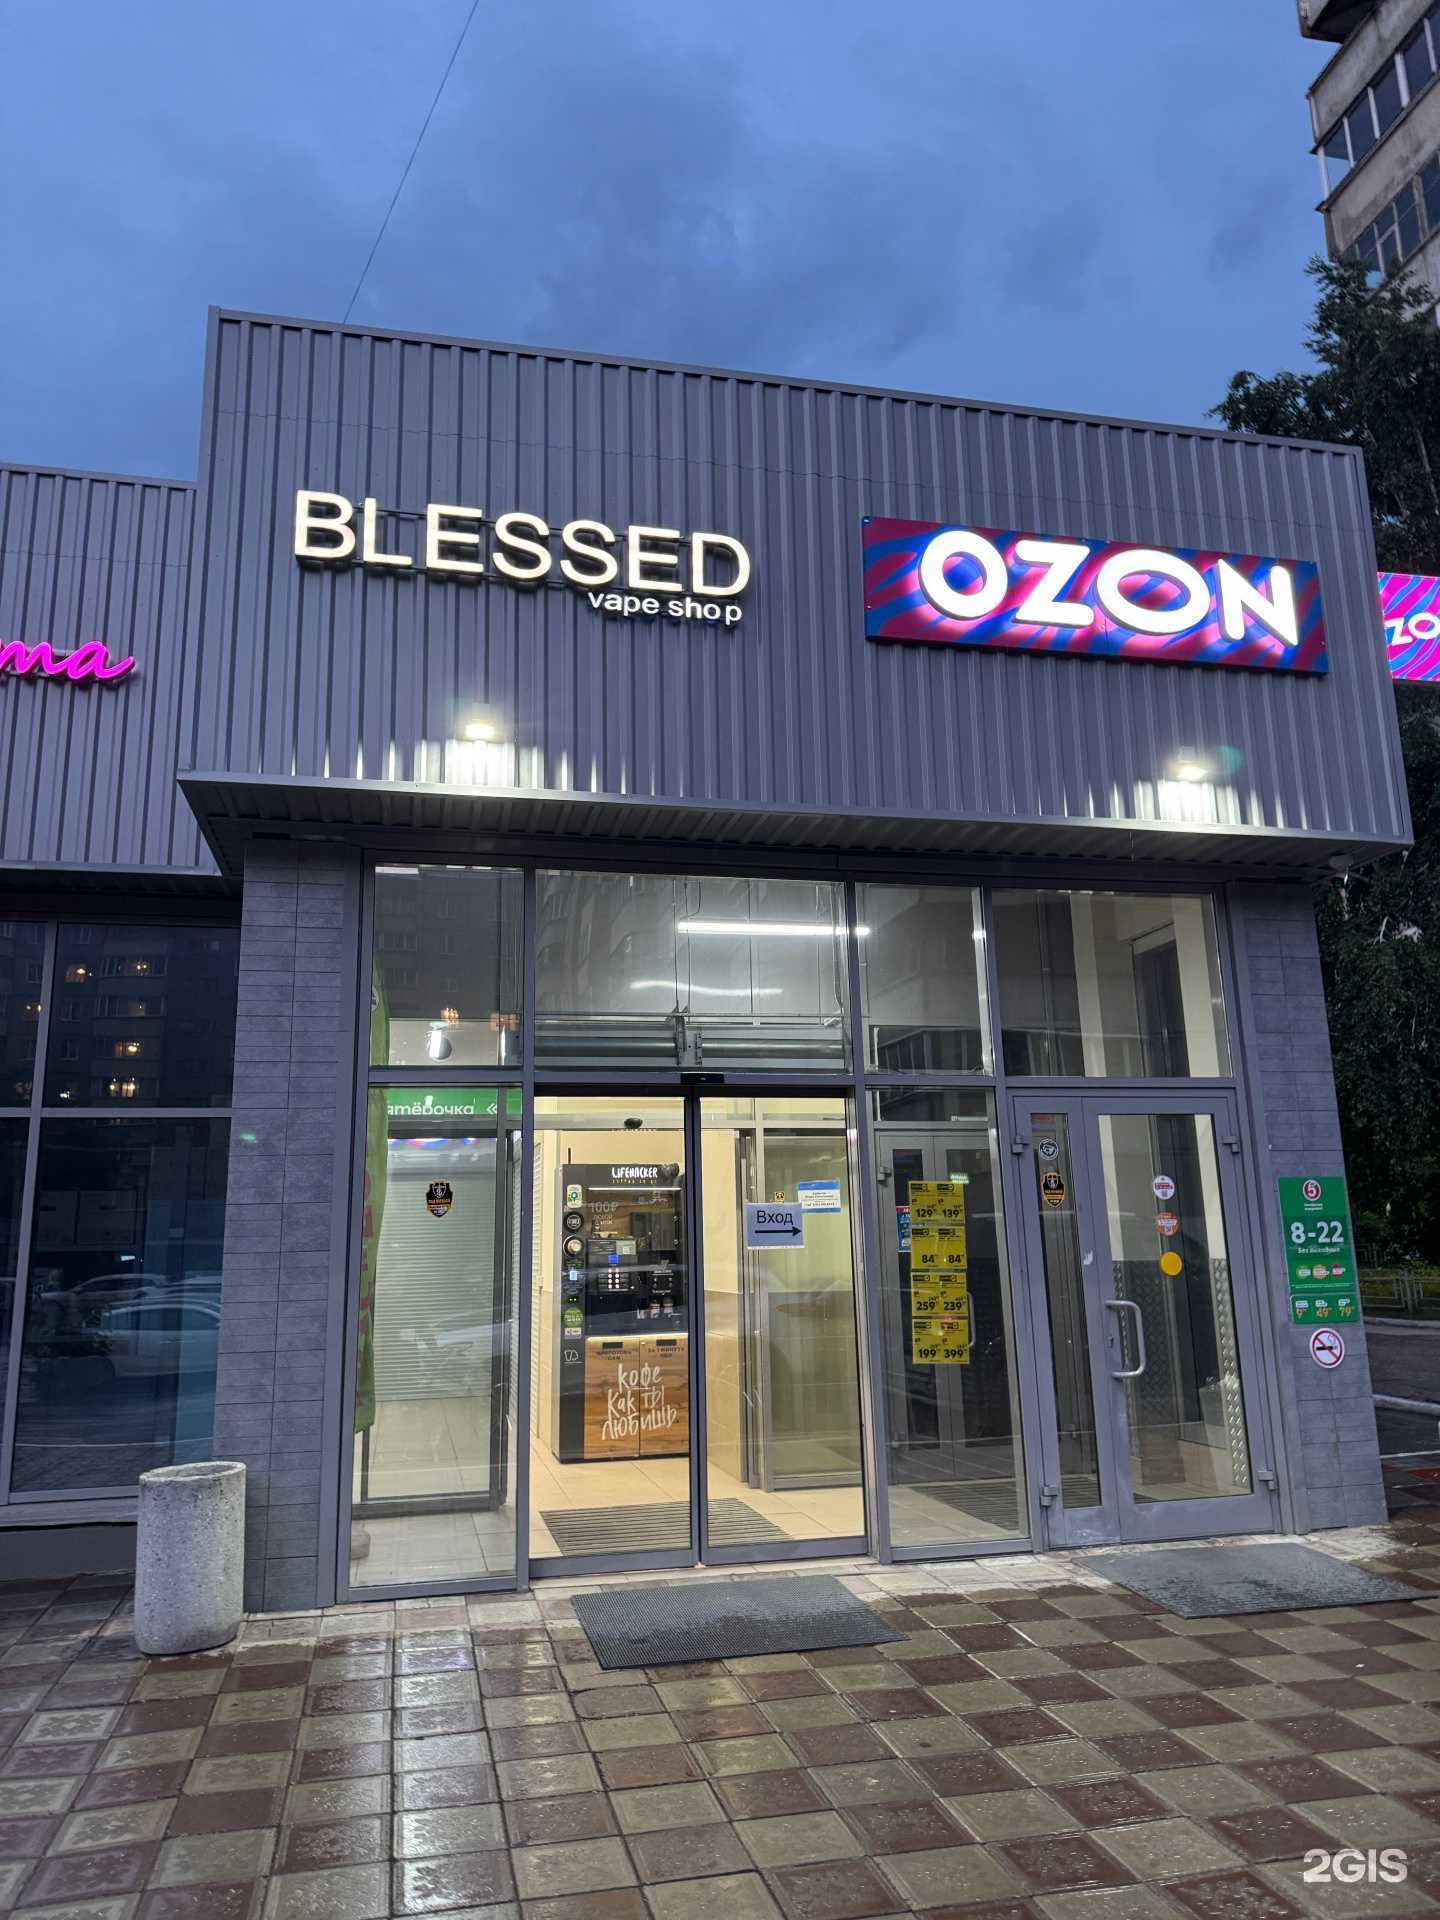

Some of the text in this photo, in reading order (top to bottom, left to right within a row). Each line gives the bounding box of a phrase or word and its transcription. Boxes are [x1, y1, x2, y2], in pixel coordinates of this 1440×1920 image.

[294, 490, 750, 596] BLESSED
[919, 530, 1298, 646] OZON
[588, 592, 742, 625] vape shop
[756, 1210, 794, 1226] Вход
[1290, 1221, 1344, 1244] 8-22
